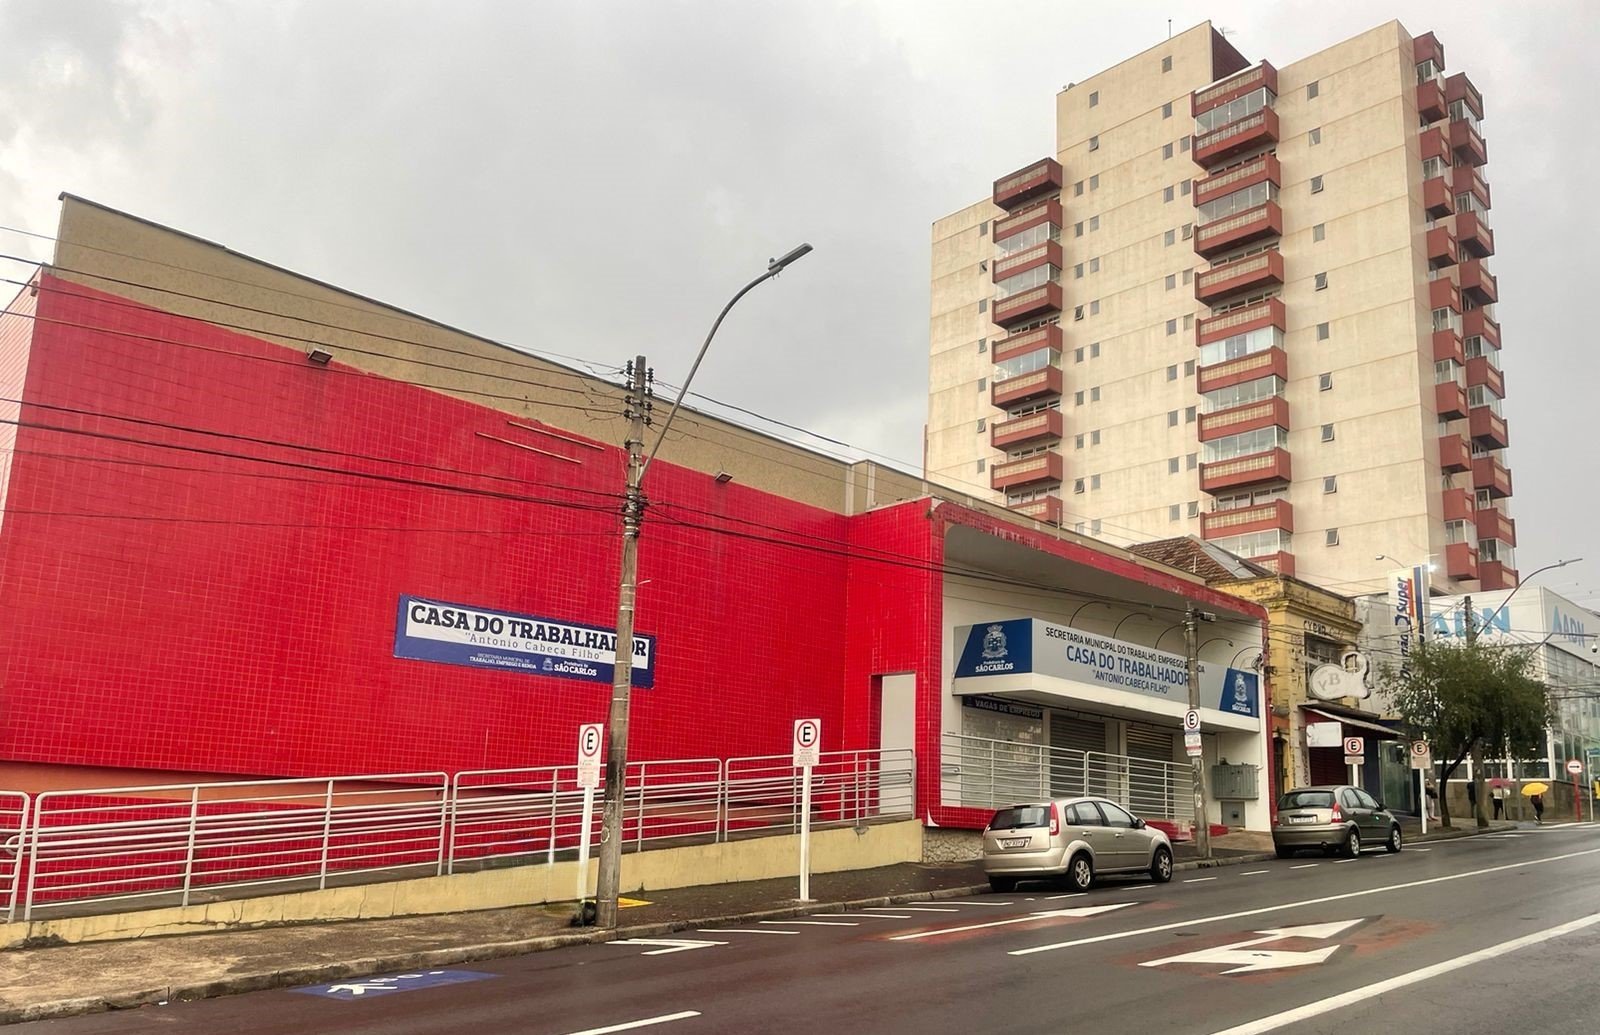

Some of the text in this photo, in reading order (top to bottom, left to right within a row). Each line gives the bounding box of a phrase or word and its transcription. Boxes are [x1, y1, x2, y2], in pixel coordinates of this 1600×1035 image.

[1396, 577, 1409, 613] Super
[411, 605, 647, 657] CASA DO TRABALHAR
[465, 632, 519, 648] "Antonio
[572, 648, 604, 660] Filho"
[1046, 627, 1084, 644] SECRETARIA
[1085, 637, 1117, 653] MUNICIPAL
[1118, 645, 1127, 655] DO
[1158, 655, 1184, 668] EMPREGO
[1067, 645, 1097, 666] CASA
[1099, 653, 1115, 670] DO
[554, 663, 597, 676] SÃO CARLOS
[975, 663, 1014, 672] SÃO CARLOS
[1125, 676, 1150, 691] CABEÇA
[975, 699, 998, 710] VAGAS
[999, 704, 1008, 712] DE
[1189, 714, 1195, 725] E
[586, 733, 594, 750] E
[803, 726, 811, 742] E
[1351, 741, 1357, 750] E
